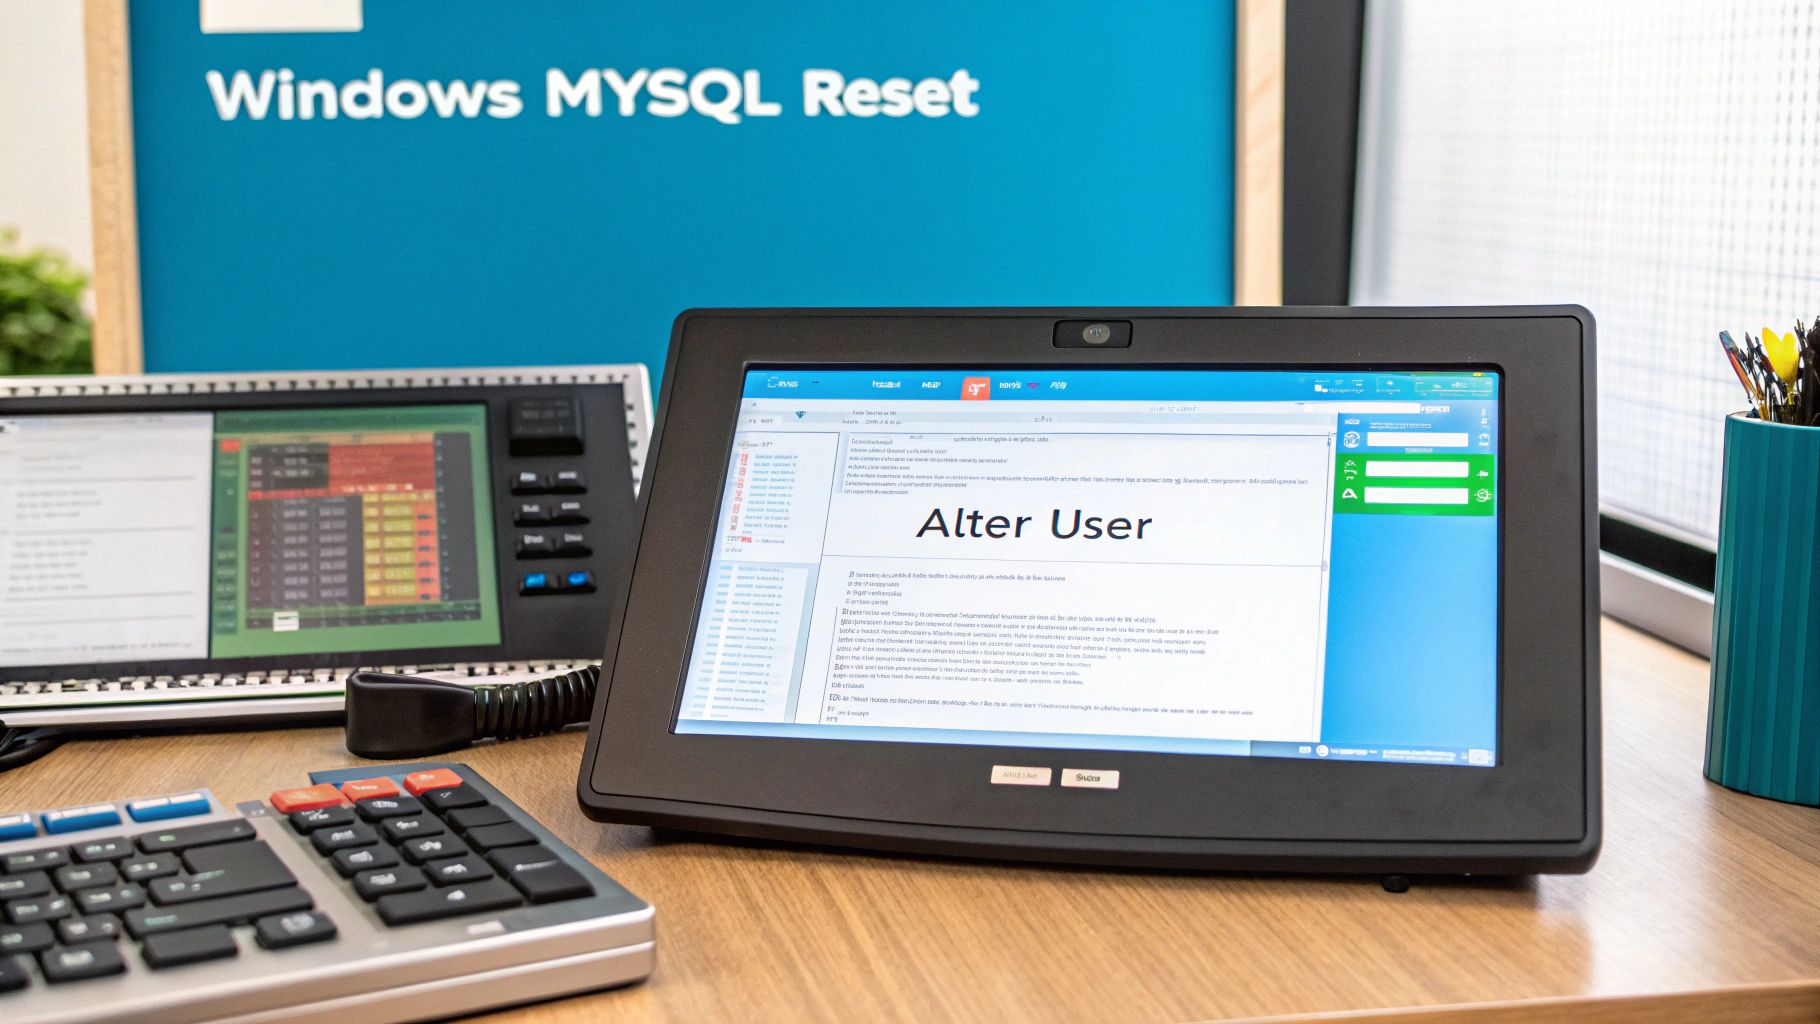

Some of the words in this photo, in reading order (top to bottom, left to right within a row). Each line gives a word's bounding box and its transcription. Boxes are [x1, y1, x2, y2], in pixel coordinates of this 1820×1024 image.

[206, 68, 523, 121] Windows
[545, 67, 782, 125] MYSQL
[802, 68, 981, 118] Reset
[916, 507, 1032, 539] Alter
[1051, 508, 1153, 540] User
